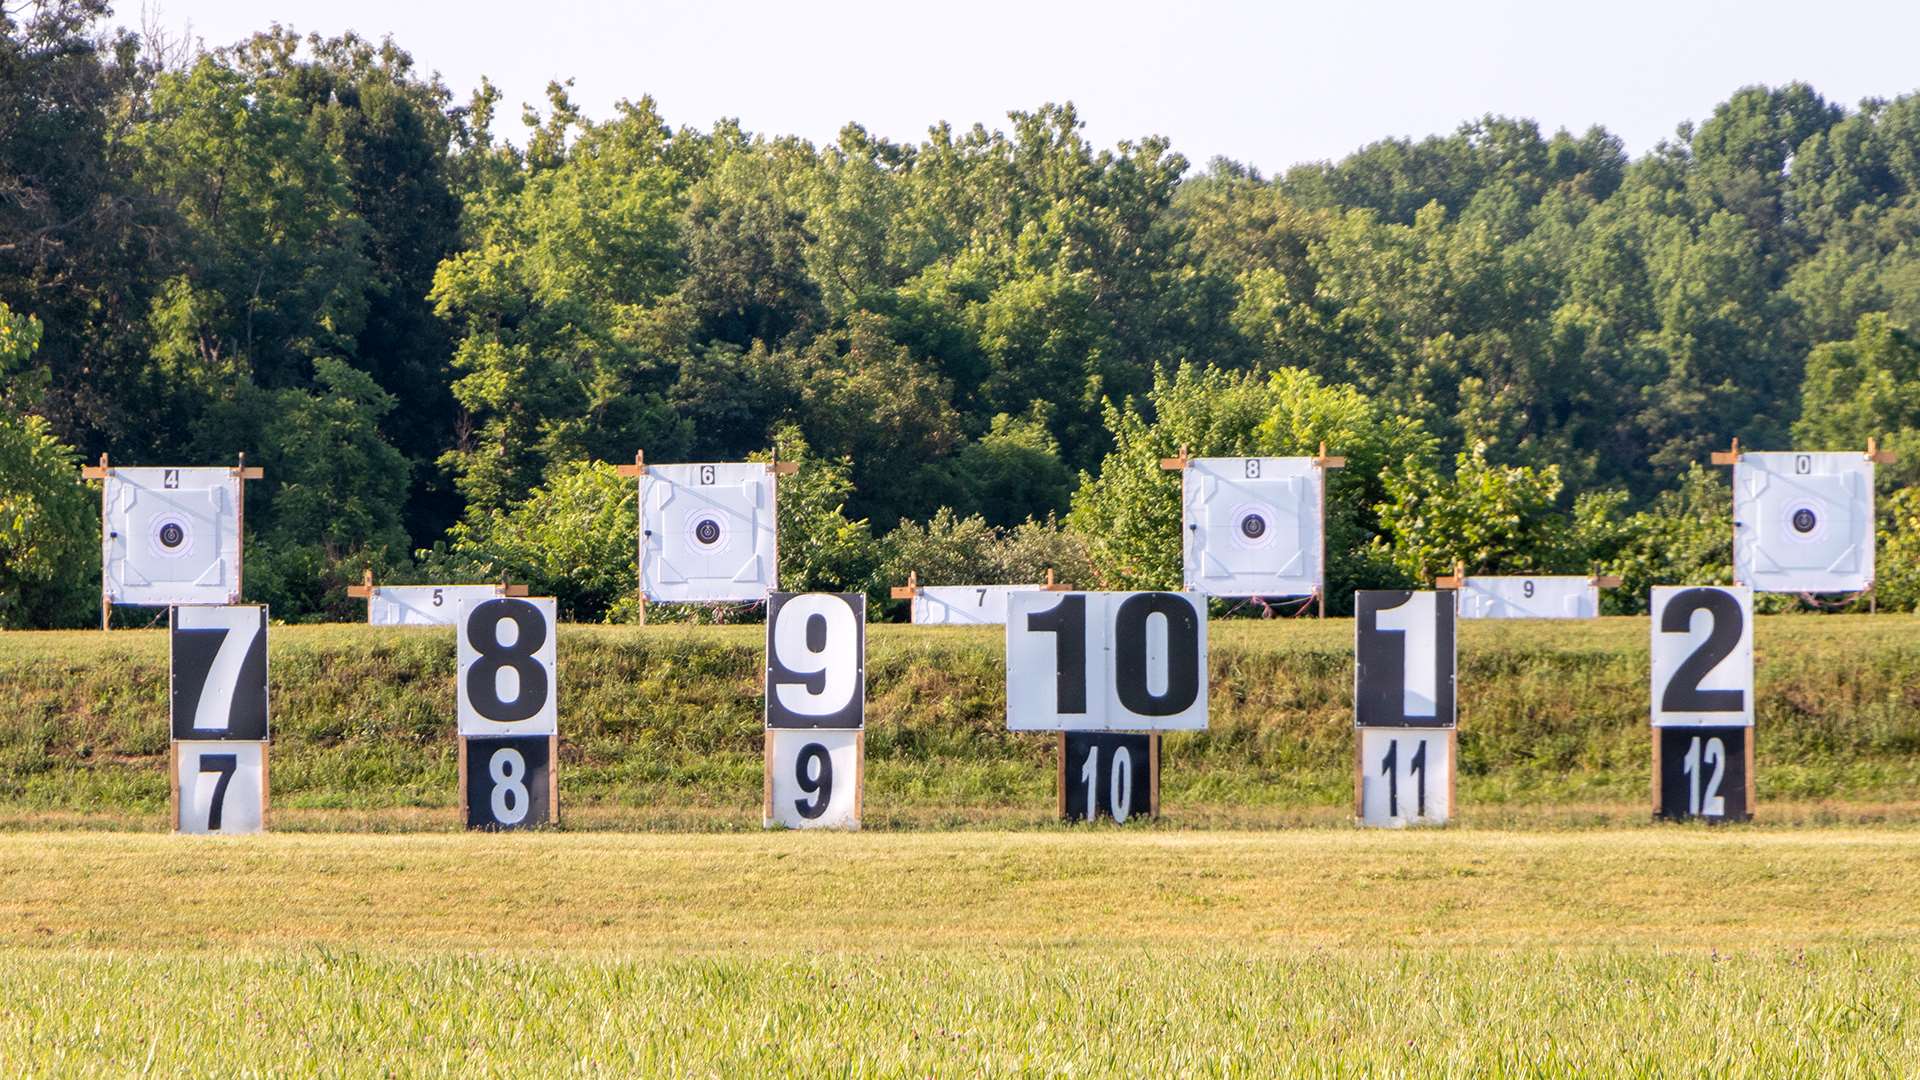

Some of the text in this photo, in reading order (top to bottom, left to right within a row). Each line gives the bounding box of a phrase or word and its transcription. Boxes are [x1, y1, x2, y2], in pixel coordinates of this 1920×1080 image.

[165, 470, 178, 488] 4
[702, 466, 714, 484] 6
[1247, 461, 1259, 478] 8
[1798, 456, 1809, 472] 0
[433, 589, 443, 607] 5
[976, 589, 987, 607] 7
[1523, 581, 1534, 598] 9
[177, 607, 260, 729] 7
[466, 599, 549, 722] 8
[774, 594, 858, 717] 9
[1027, 593, 1199, 717] 10
[1376, 591, 1437, 717] 1
[1661, 588, 1745, 712] 2
[199, 754, 237, 830] 7
[489, 748, 529, 824] 8
[795, 743, 833, 820] 9
[1081, 745, 1132, 824] 10
[1381, 740, 1426, 817] 11
[1683, 736, 1726, 816] 12
